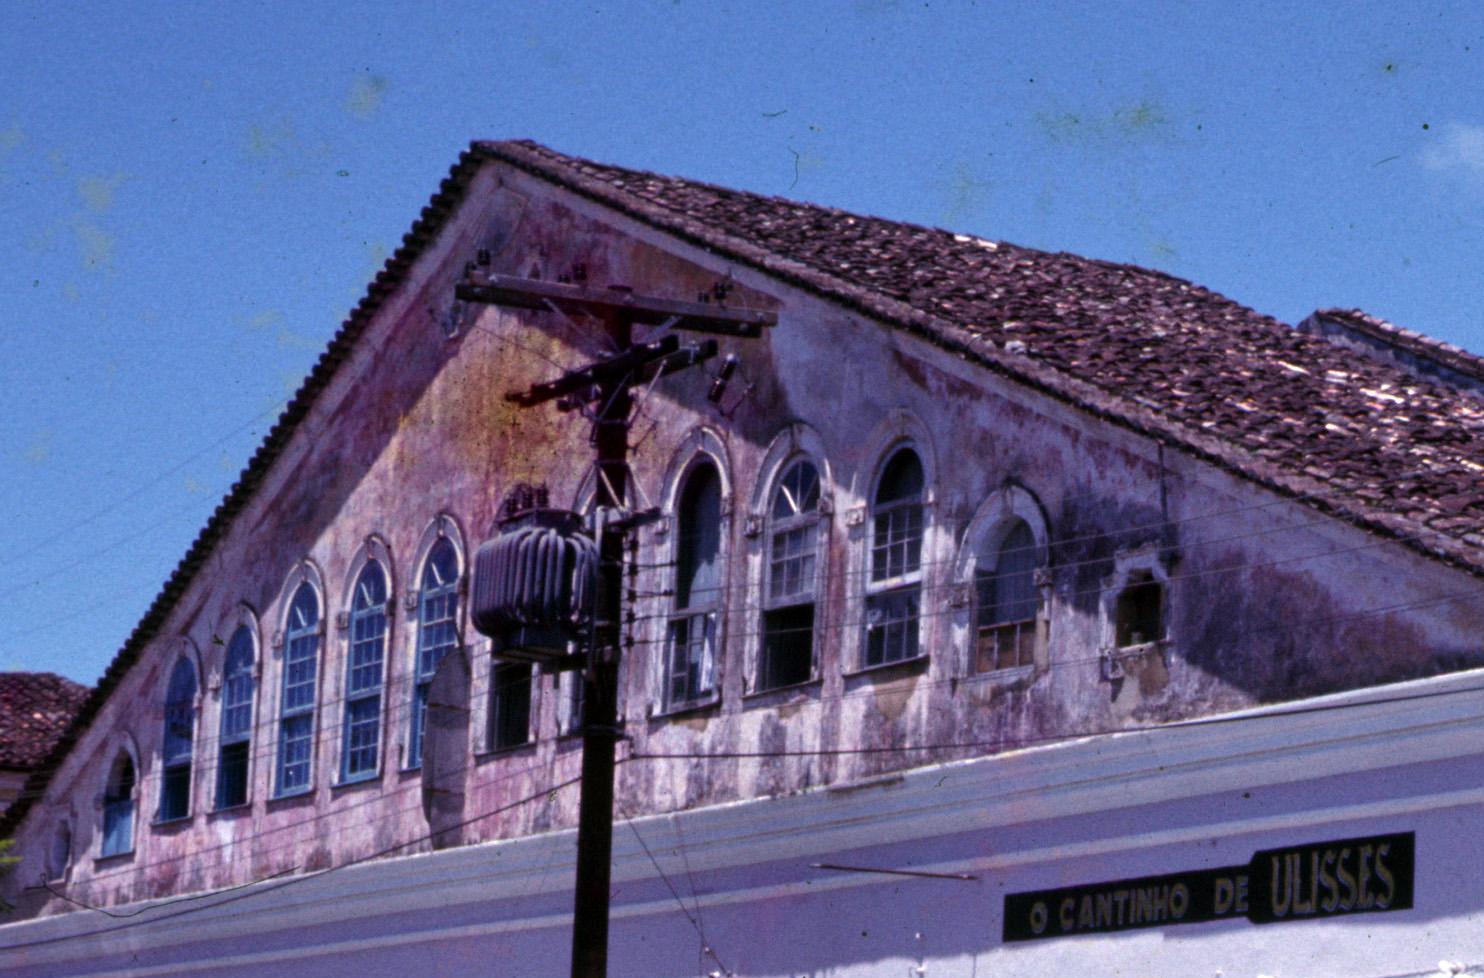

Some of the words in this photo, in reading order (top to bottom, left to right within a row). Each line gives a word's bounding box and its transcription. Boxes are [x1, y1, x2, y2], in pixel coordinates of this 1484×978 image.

[1029, 906, 1048, 934] O
[1059, 883, 1190, 931] CANTINHO
[1213, 876, 1249, 915] DE
[1271, 843, 1395, 917] ULISSES
